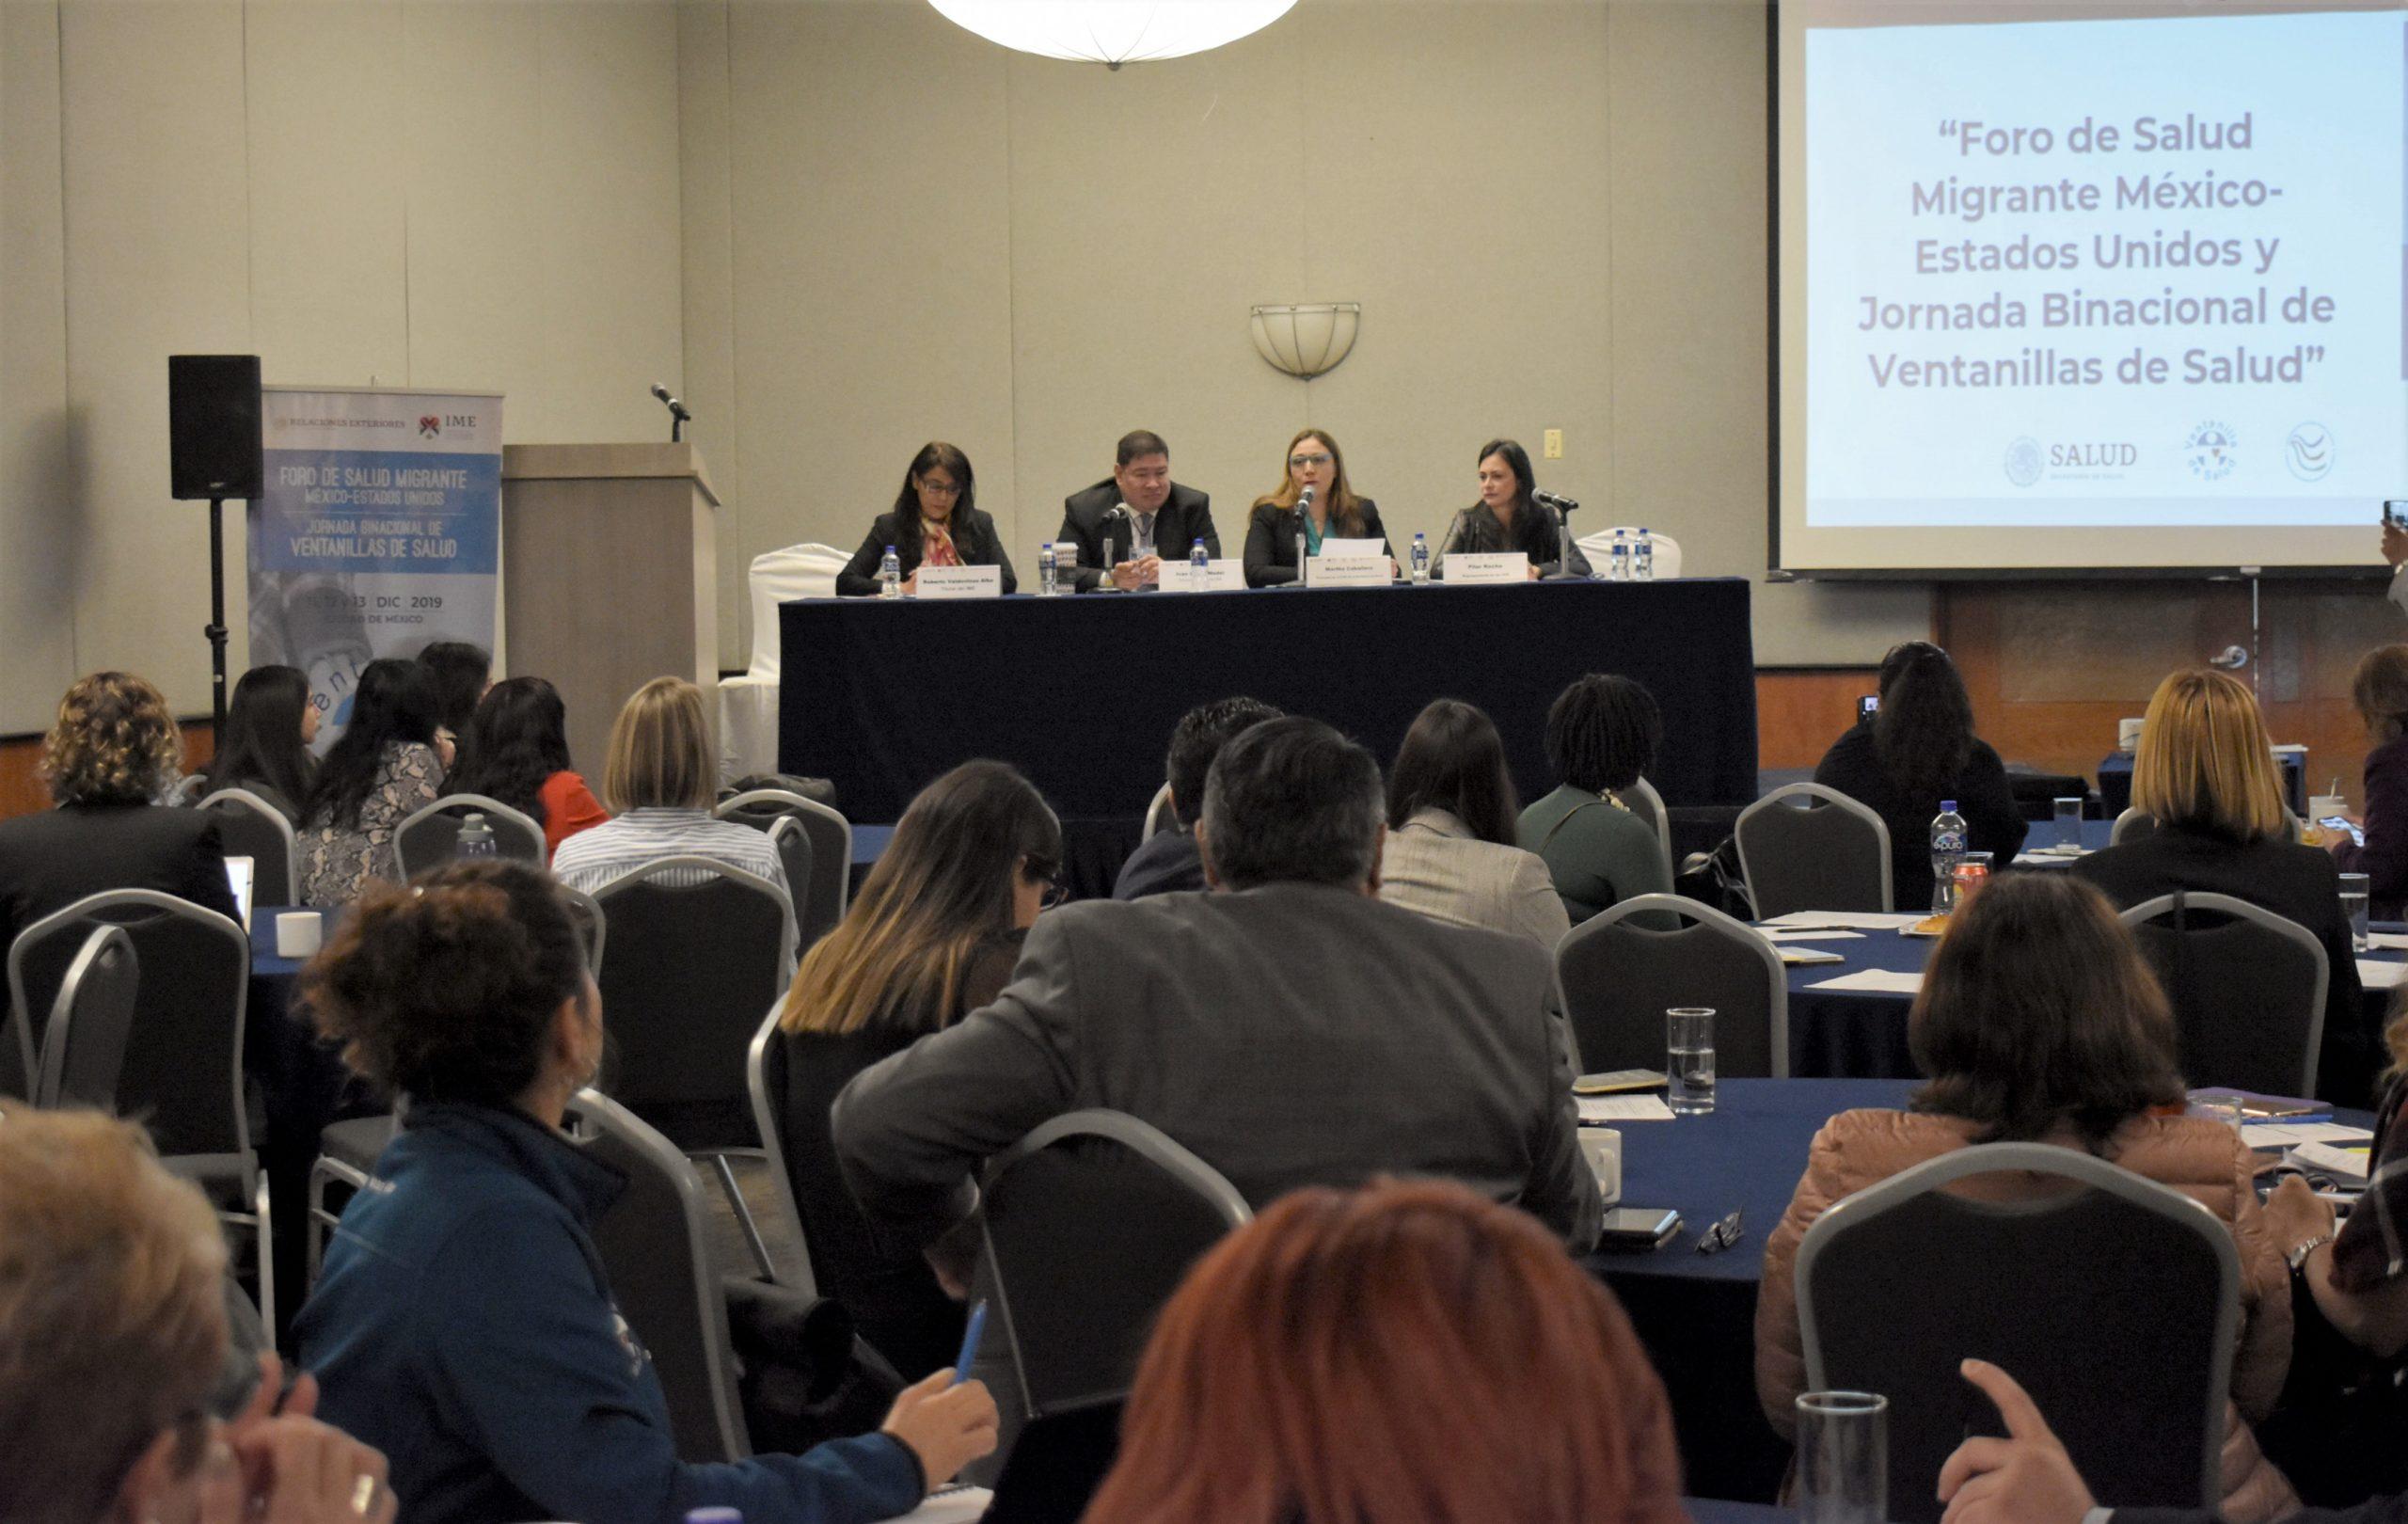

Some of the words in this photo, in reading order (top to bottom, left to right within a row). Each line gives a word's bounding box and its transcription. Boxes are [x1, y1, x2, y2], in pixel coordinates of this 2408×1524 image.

[1938, 119, 2054, 156] “Foro
[2067, 116, 2120, 153] de
[2132, 111, 2253, 152] Salud
[1911, 175, 2101, 222] Migrante
[2115, 169, 2283, 211] México-
[1915, 233, 2080, 275] Estados
[2094, 230, 2242, 269] Unidos
[2254, 237, 2281, 276] y
[1858, 292, 2027, 332] Jornada
[2042, 286, 2267, 329] Binacional
[2281, 286, 2337, 325] de
[1867, 347, 2103, 389] Ventanillas
[2116, 347, 2170, 387] de
[2182, 344, 2326, 386] Salud”
[445, 415, 477, 428] IME
[2050, 443, 2138, 468] SALUD
[279, 467, 317, 487] FORO
[322, 468, 341, 487] DE
[345, 468, 390, 488] SALUD
[395, 468, 467, 489] MIGRANTE
[305, 488, 402, 505] MÉXICO-ESTADOS
[404, 490, 445, 506] UNIDOS
[308, 519, 356, 535] JORNADA
[360, 520, 423, 536] BINACIONAL
[428, 520, 442, 536] DE
[291, 537, 387, 558] VENTANILLAS
[390, 538, 407, 558] DE
[412, 539, 457, 559] SALUD
[376, 596, 402, 609] DIC
[411, 596, 443, 609] 2019
[368, 615, 383, 624] DE
[385, 613, 424, 625] MÉXICO
